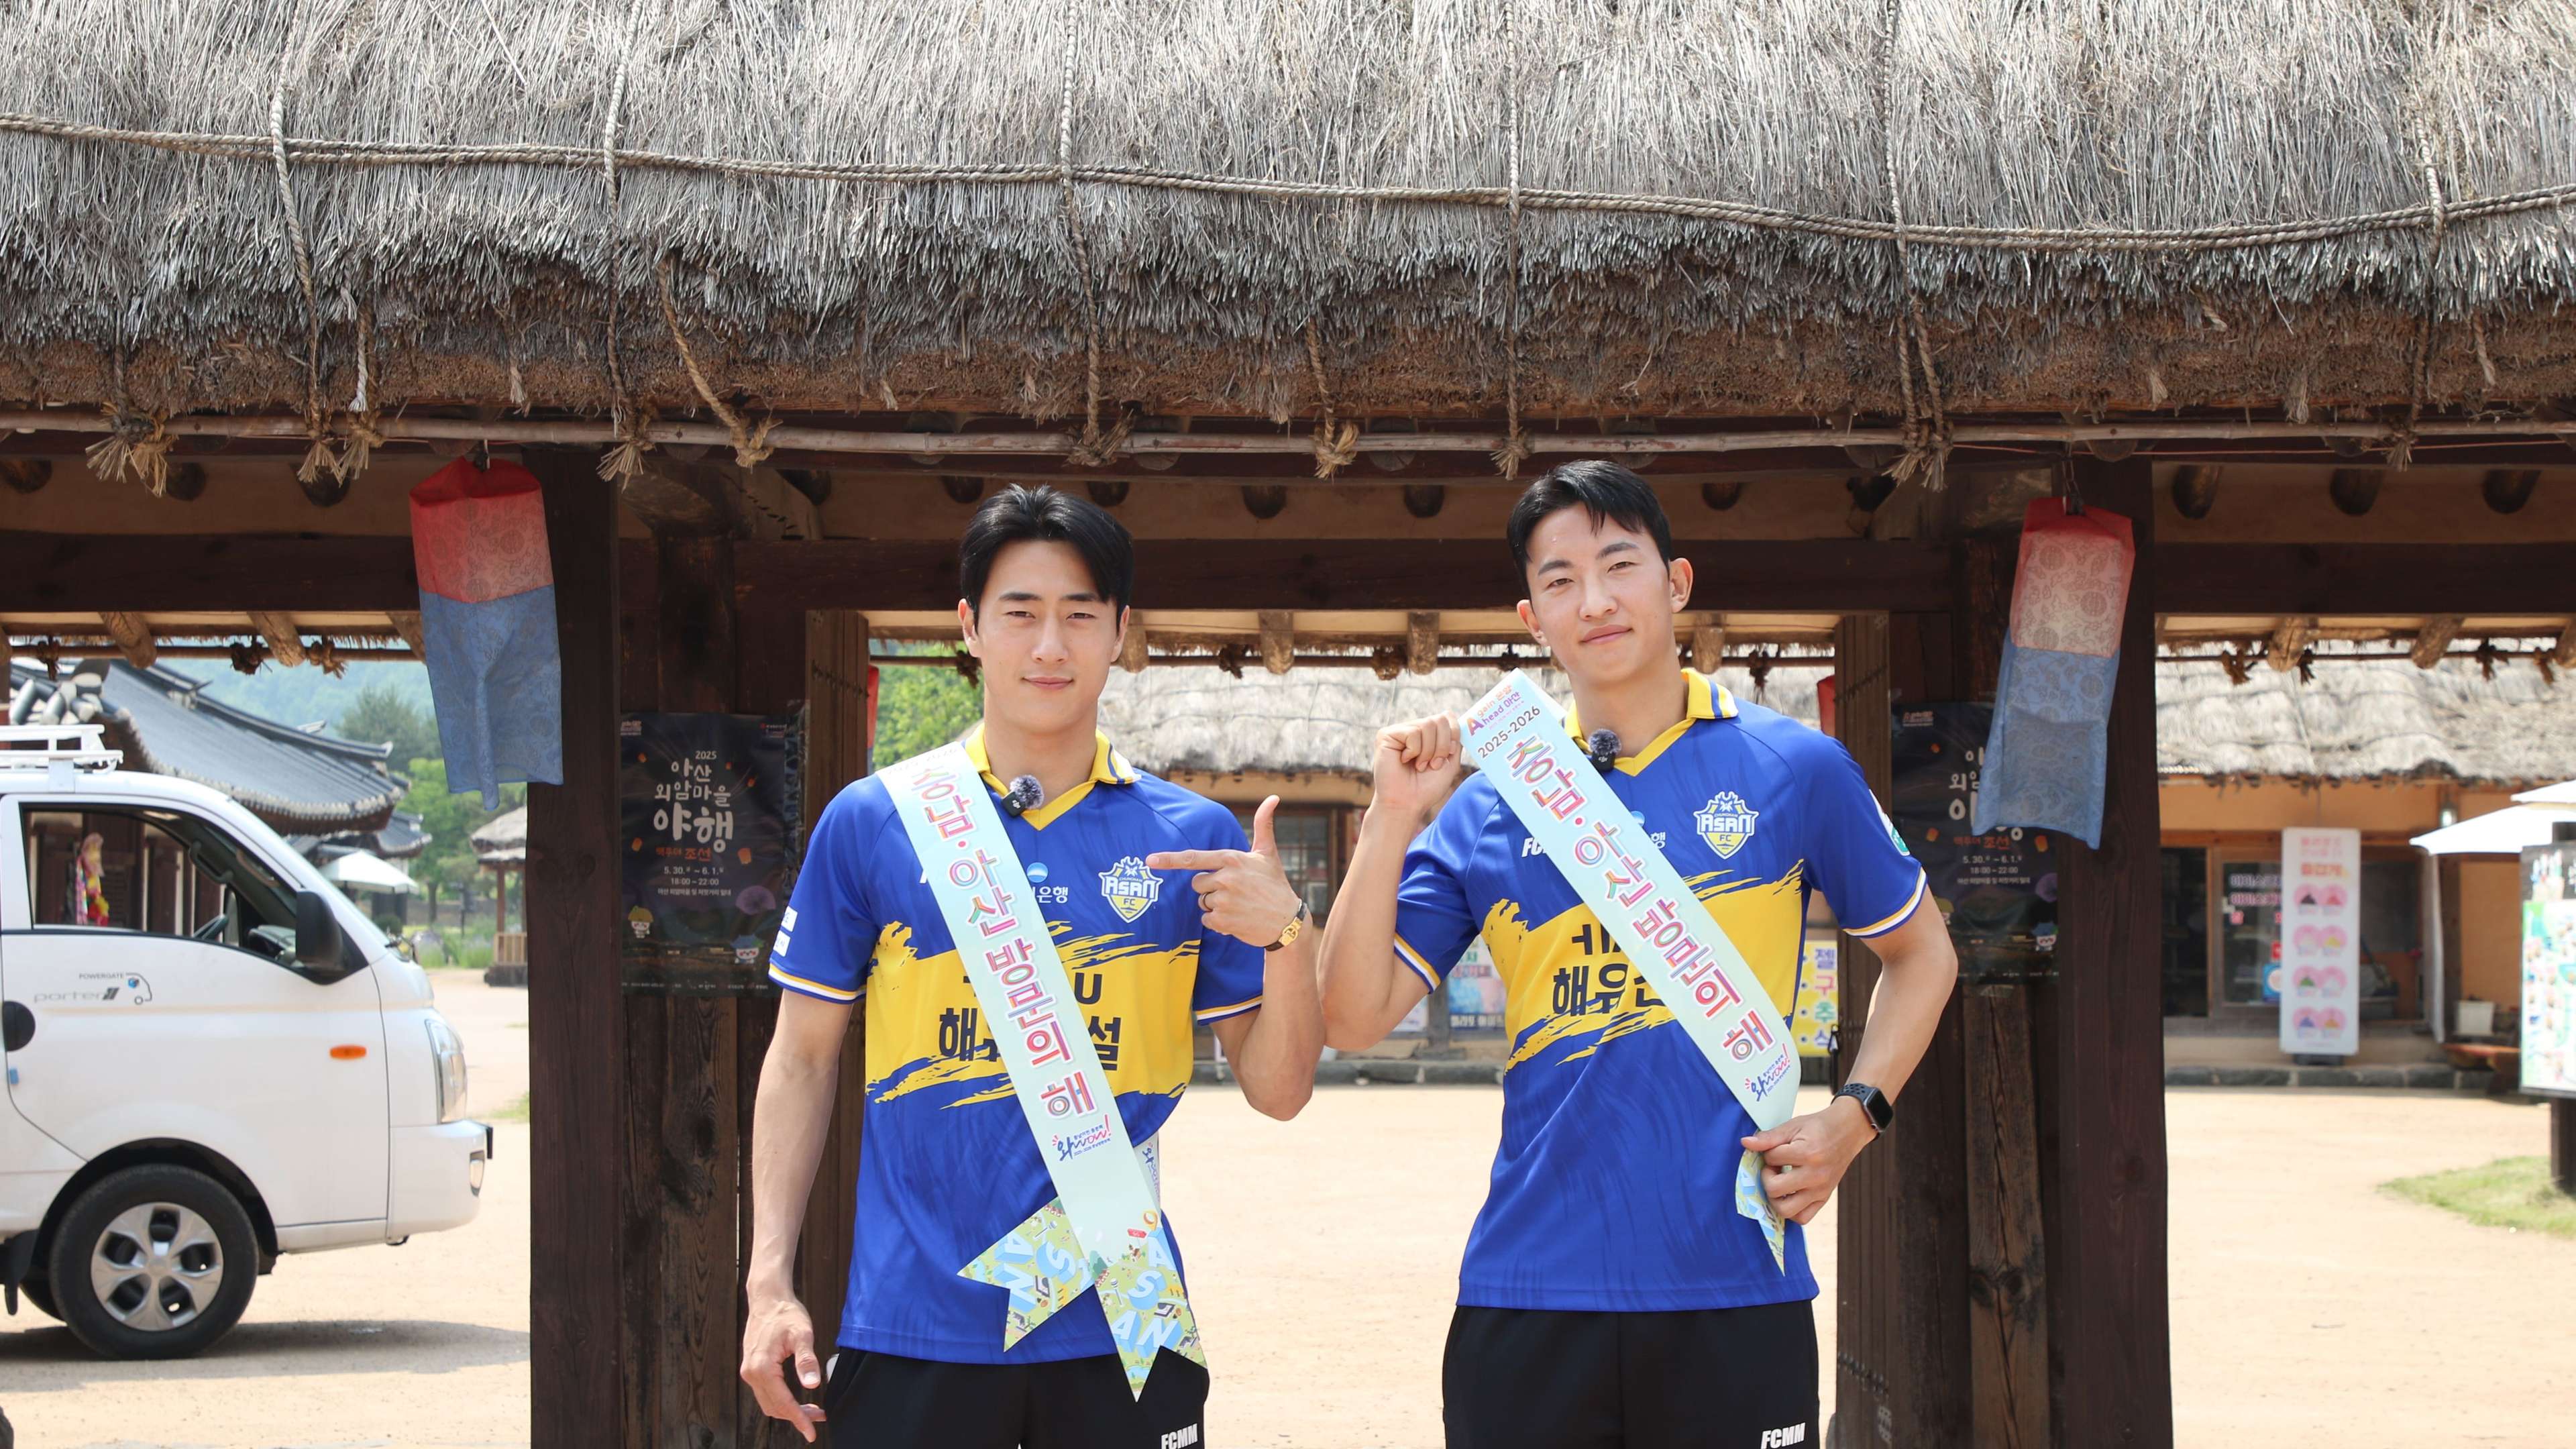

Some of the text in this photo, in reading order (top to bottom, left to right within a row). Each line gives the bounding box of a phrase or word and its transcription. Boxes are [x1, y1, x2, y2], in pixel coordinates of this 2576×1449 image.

[1477, 706, 1541, 759] 2025-2026
[695, 751, 717, 760] 2025
[671, 758, 712, 782] 아산
[654, 780, 731, 807] 외암마을
[653, 804, 734, 853] 야행
[1699, 814, 1754, 833] ASAN
[1719, 834, 1732, 842] FC
[684, 847, 712, 862] 조선
[671, 877, 691, 885] 18:00
[698, 877, 719, 885] 22:00
[1105, 876, 1157, 900] ASAN
[1032, 885, 1069, 904] 은행
[1123, 898, 1136, 906] FC
[1635, 896, 1742, 1018] 방문의
[1723, 1009, 1774, 1061] 해
[985, 938, 1071, 1066] 방문의
[1040, 1071, 1096, 1115] 해
[1161, 1423, 1199, 1449] FCMM
[1760, 1422, 1806, 1449] FCMM
